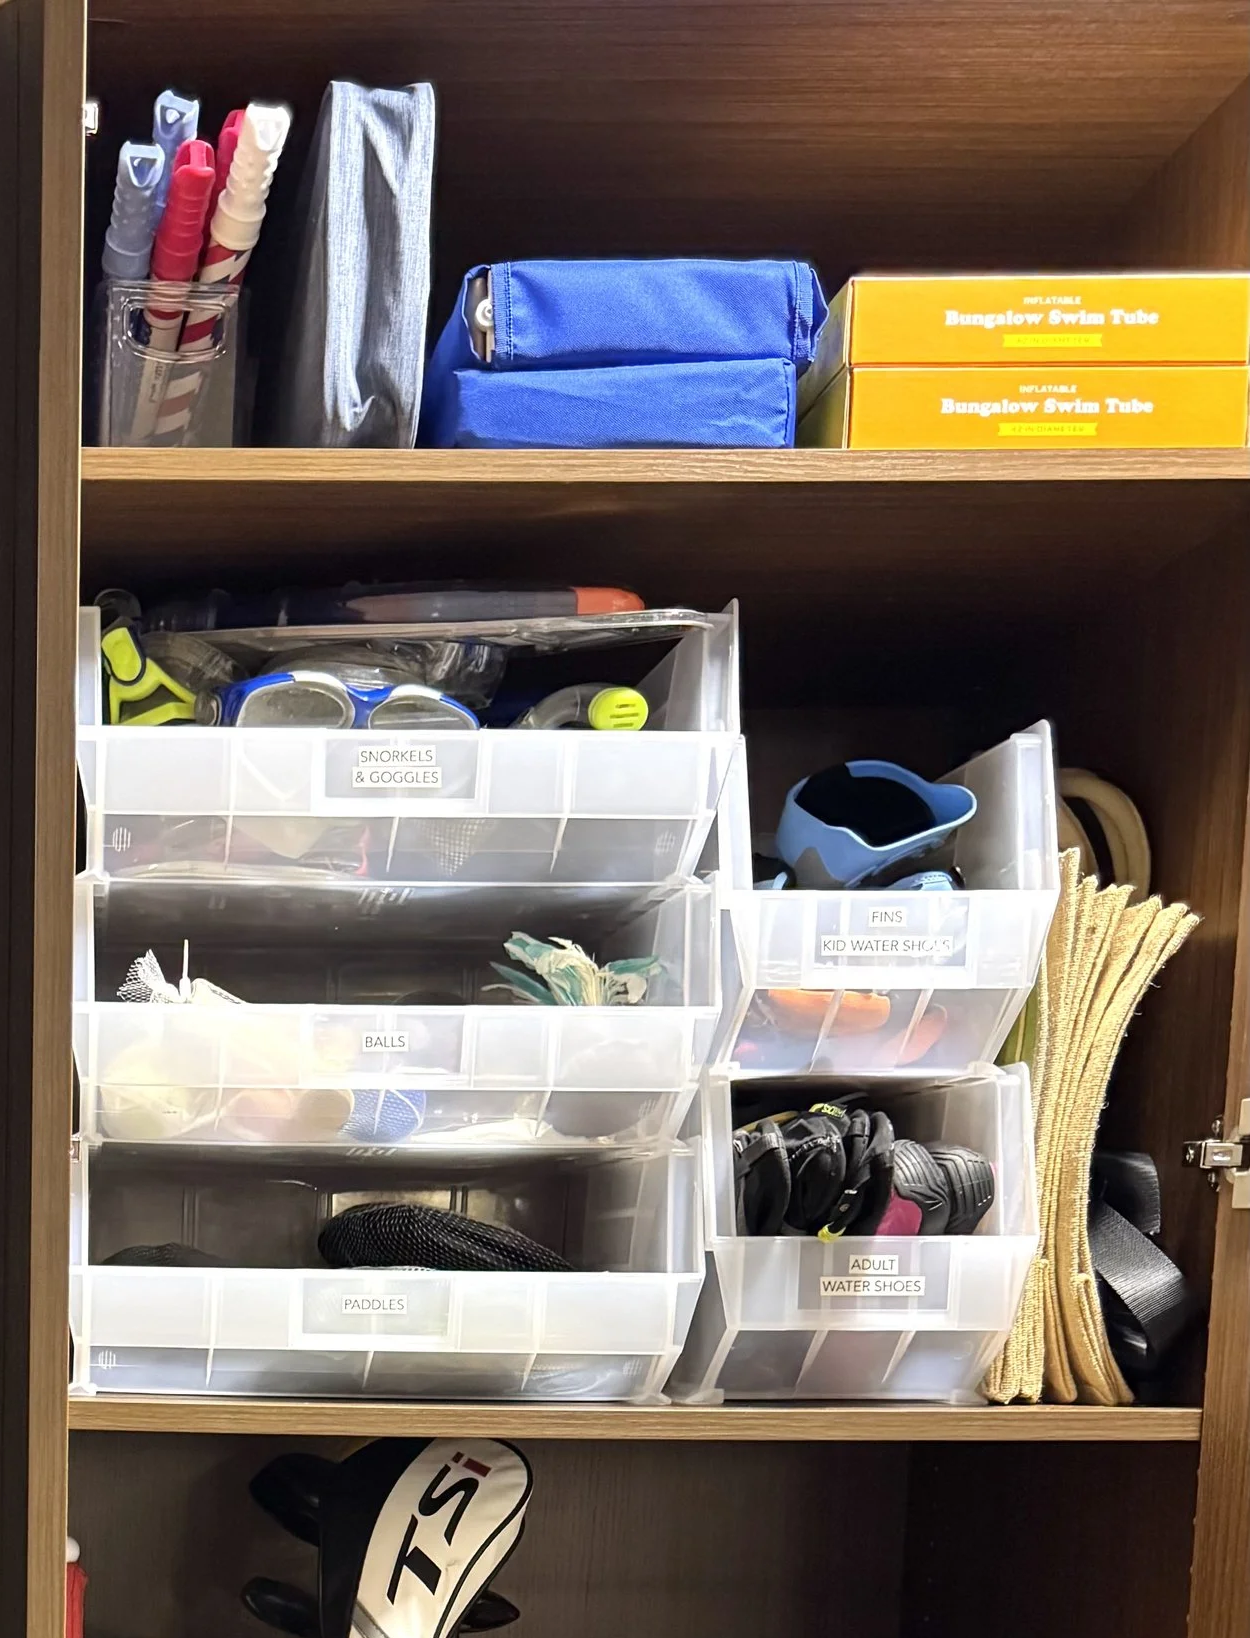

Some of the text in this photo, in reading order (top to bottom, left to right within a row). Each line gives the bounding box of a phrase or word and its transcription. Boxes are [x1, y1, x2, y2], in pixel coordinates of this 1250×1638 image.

[1023, 296, 1081, 305] INFLATABLE
[945, 309, 1159, 328] Bungalow Swim Tube
[1019, 385, 1077, 393] INFLATABLE
[941, 398, 1154, 416] Bungalow Swim Tube
[360, 749, 433, 763] SNORKELS
[355, 770, 439, 784] & GOGGLES
[871, 910, 903, 924] FINS
[823, 939, 847, 952] KID
[850, 939, 899, 952] WATER
[365, 1035, 406, 1048] BALLS
[850, 1257, 896, 1271] ADULT
[821, 1279, 922, 1293] WATER SHOES
[344, 1298, 405, 1311] PADDLES
